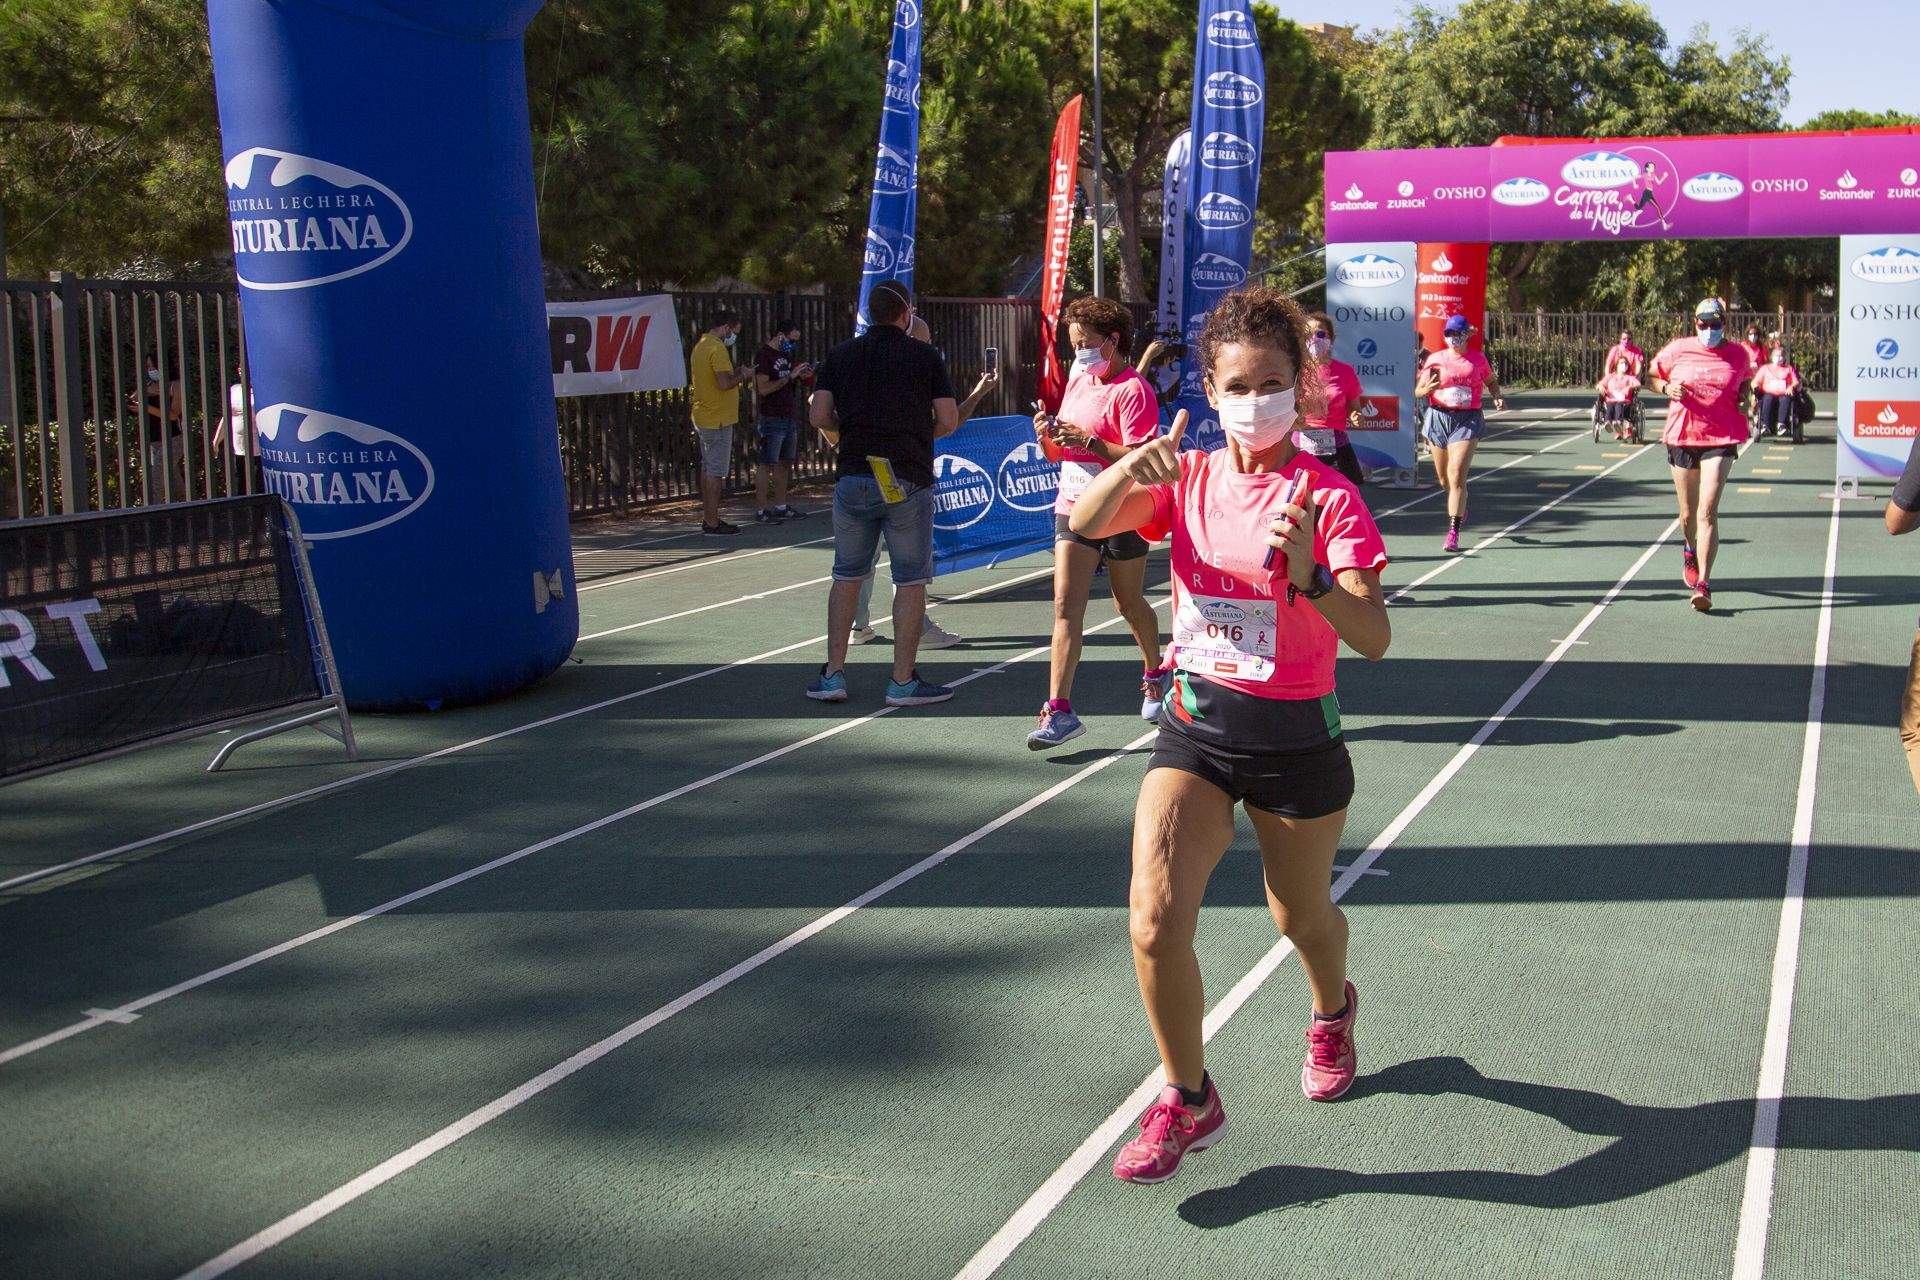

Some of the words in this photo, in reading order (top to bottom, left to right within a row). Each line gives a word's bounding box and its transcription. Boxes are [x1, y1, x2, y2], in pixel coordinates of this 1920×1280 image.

[1568, 166, 1634, 179] ASTURIANA
[1688, 183, 1740, 194] ASTURIANA
[1751, 178, 1808, 193] OYSHO
[1434, 186, 1487, 200] OYSHO
[1498, 189, 1545, 199] ASTURIANA
[1819, 189, 1875, 201] Santander
[280, 194, 376, 210] LECHERA
[1330, 201, 1379, 212] Santander
[1387, 199, 1426, 209] ZURICH
[1570, 206, 1582, 220] de
[1585, 205, 1594, 220] la
[1591, 206, 1643, 235] Mujer
[232, 214, 390, 254] STURIANA
[1339, 268, 1401, 280] ASTURIANA
[1417, 272, 1472, 286] Santander
[1335, 306, 1405, 323] OYSHO
[1354, 364, 1395, 377] URICH
[1856, 367, 1918, 379] ZURICH
[1858, 423, 1917, 437] Santander
[262, 448, 300, 464] ENTRAL
[307, 449, 398, 464] LECHERA
[264, 466, 413, 504] TURIANA
[1005, 471, 1061, 499] ASTURIA
[933, 484, 989, 514] STURIANA
[1191, 548, 1223, 569] WE
[1204, 609, 1244, 620] ASTURIANA
[1207, 623, 1243, 641] 016
[0, 598, 108, 688] RT
